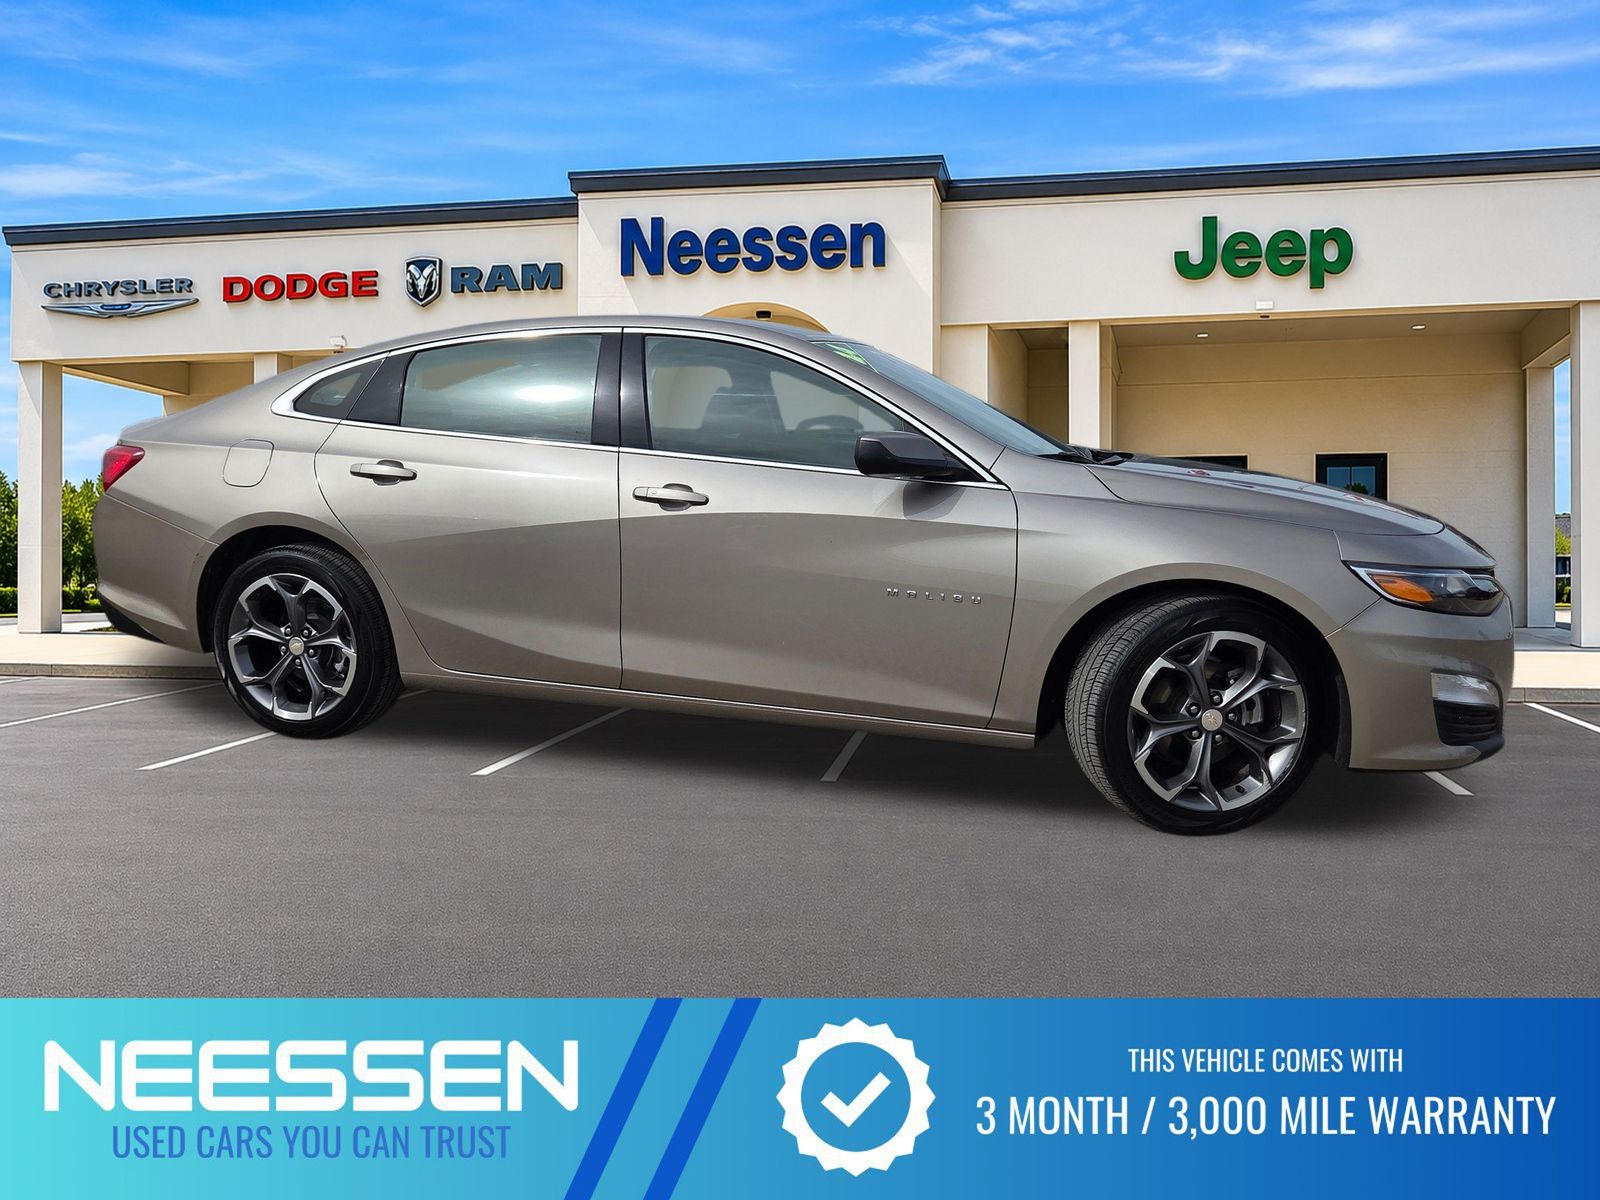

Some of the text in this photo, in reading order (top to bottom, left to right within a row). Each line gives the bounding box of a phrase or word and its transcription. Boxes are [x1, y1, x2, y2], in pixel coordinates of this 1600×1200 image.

[620, 216, 887, 277] Neessen
[1174, 215, 1355, 289] Jeep
[42, 277, 194, 299] CHRYSLER
[222, 270, 379, 303] DODGE
[450, 262, 563, 293] RAM
[886, 587, 983, 604] MALIBU
